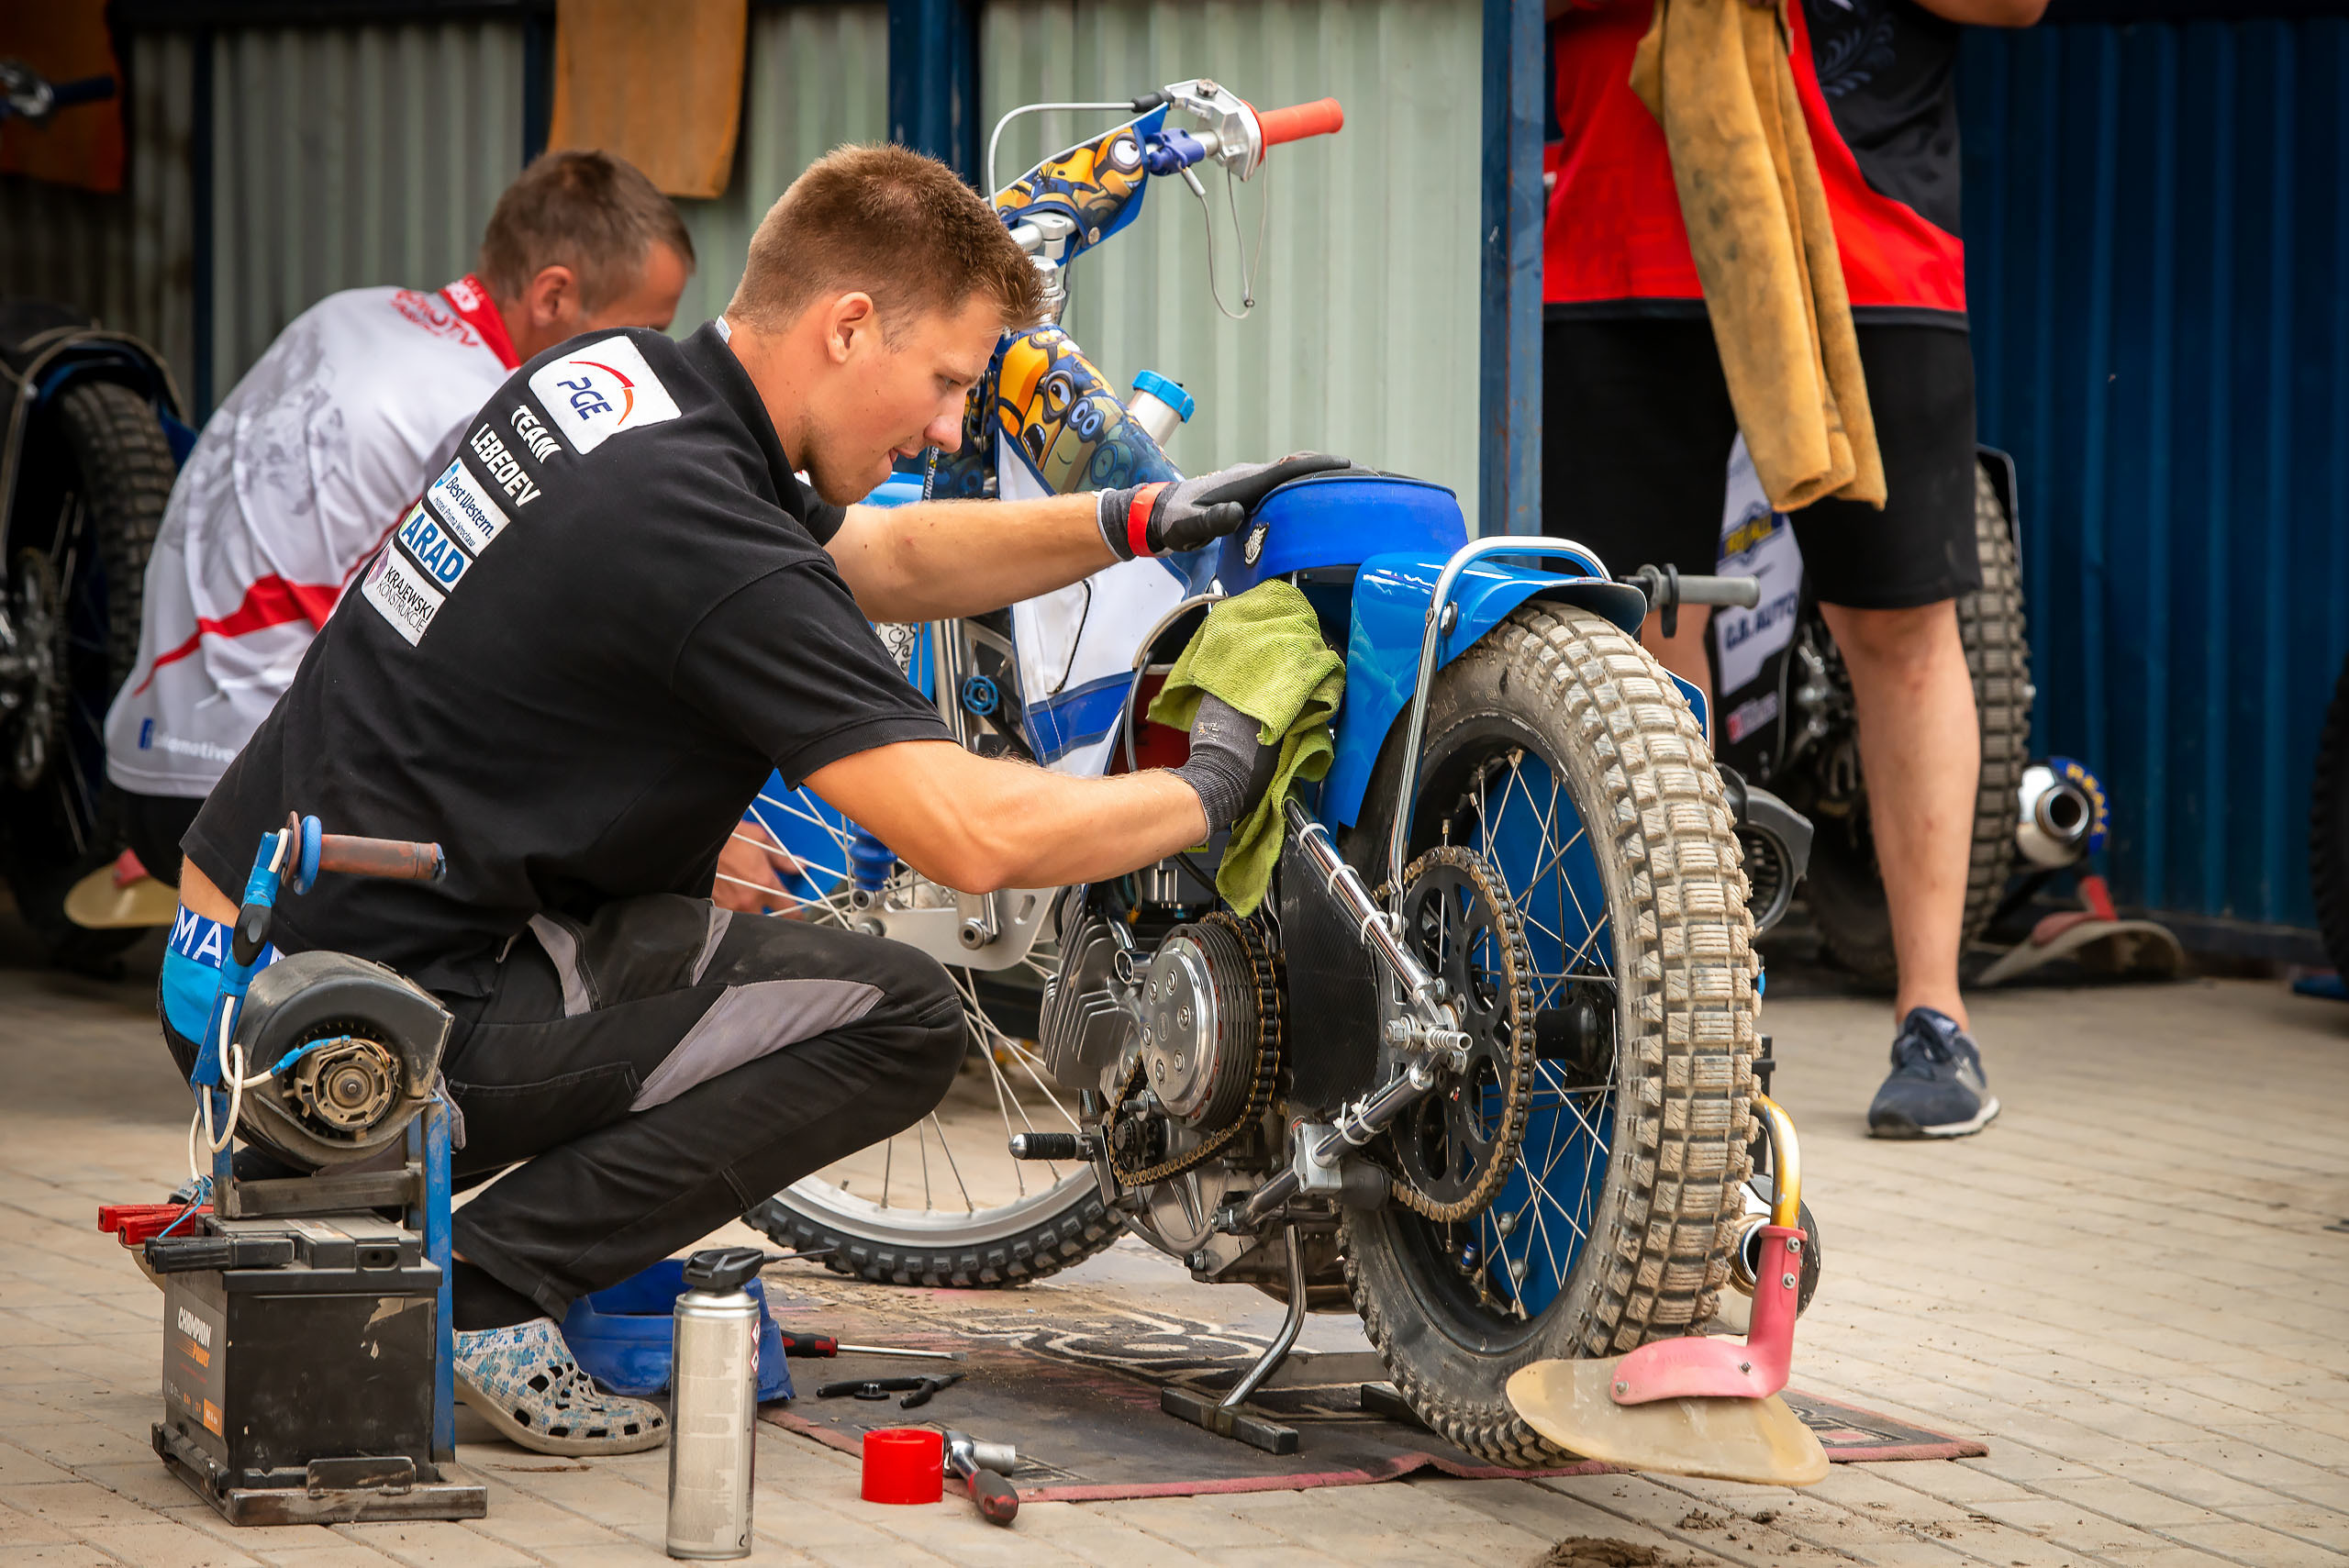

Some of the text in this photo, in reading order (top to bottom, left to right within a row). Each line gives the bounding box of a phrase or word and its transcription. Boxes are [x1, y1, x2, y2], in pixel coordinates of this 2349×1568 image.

[557, 376, 613, 420] PGE
[511, 405, 562, 464] TEAM
[433, 495, 447, 512] Hotel
[443, 506, 458, 527] Prima
[446, 476, 466, 502] Best
[401, 512, 464, 584] ARAD
[376, 579, 427, 633] KONSTRUKCJE
[384, 565, 435, 621] KRAJEWSKI
[178, 1306, 211, 1349] CHAMPION
